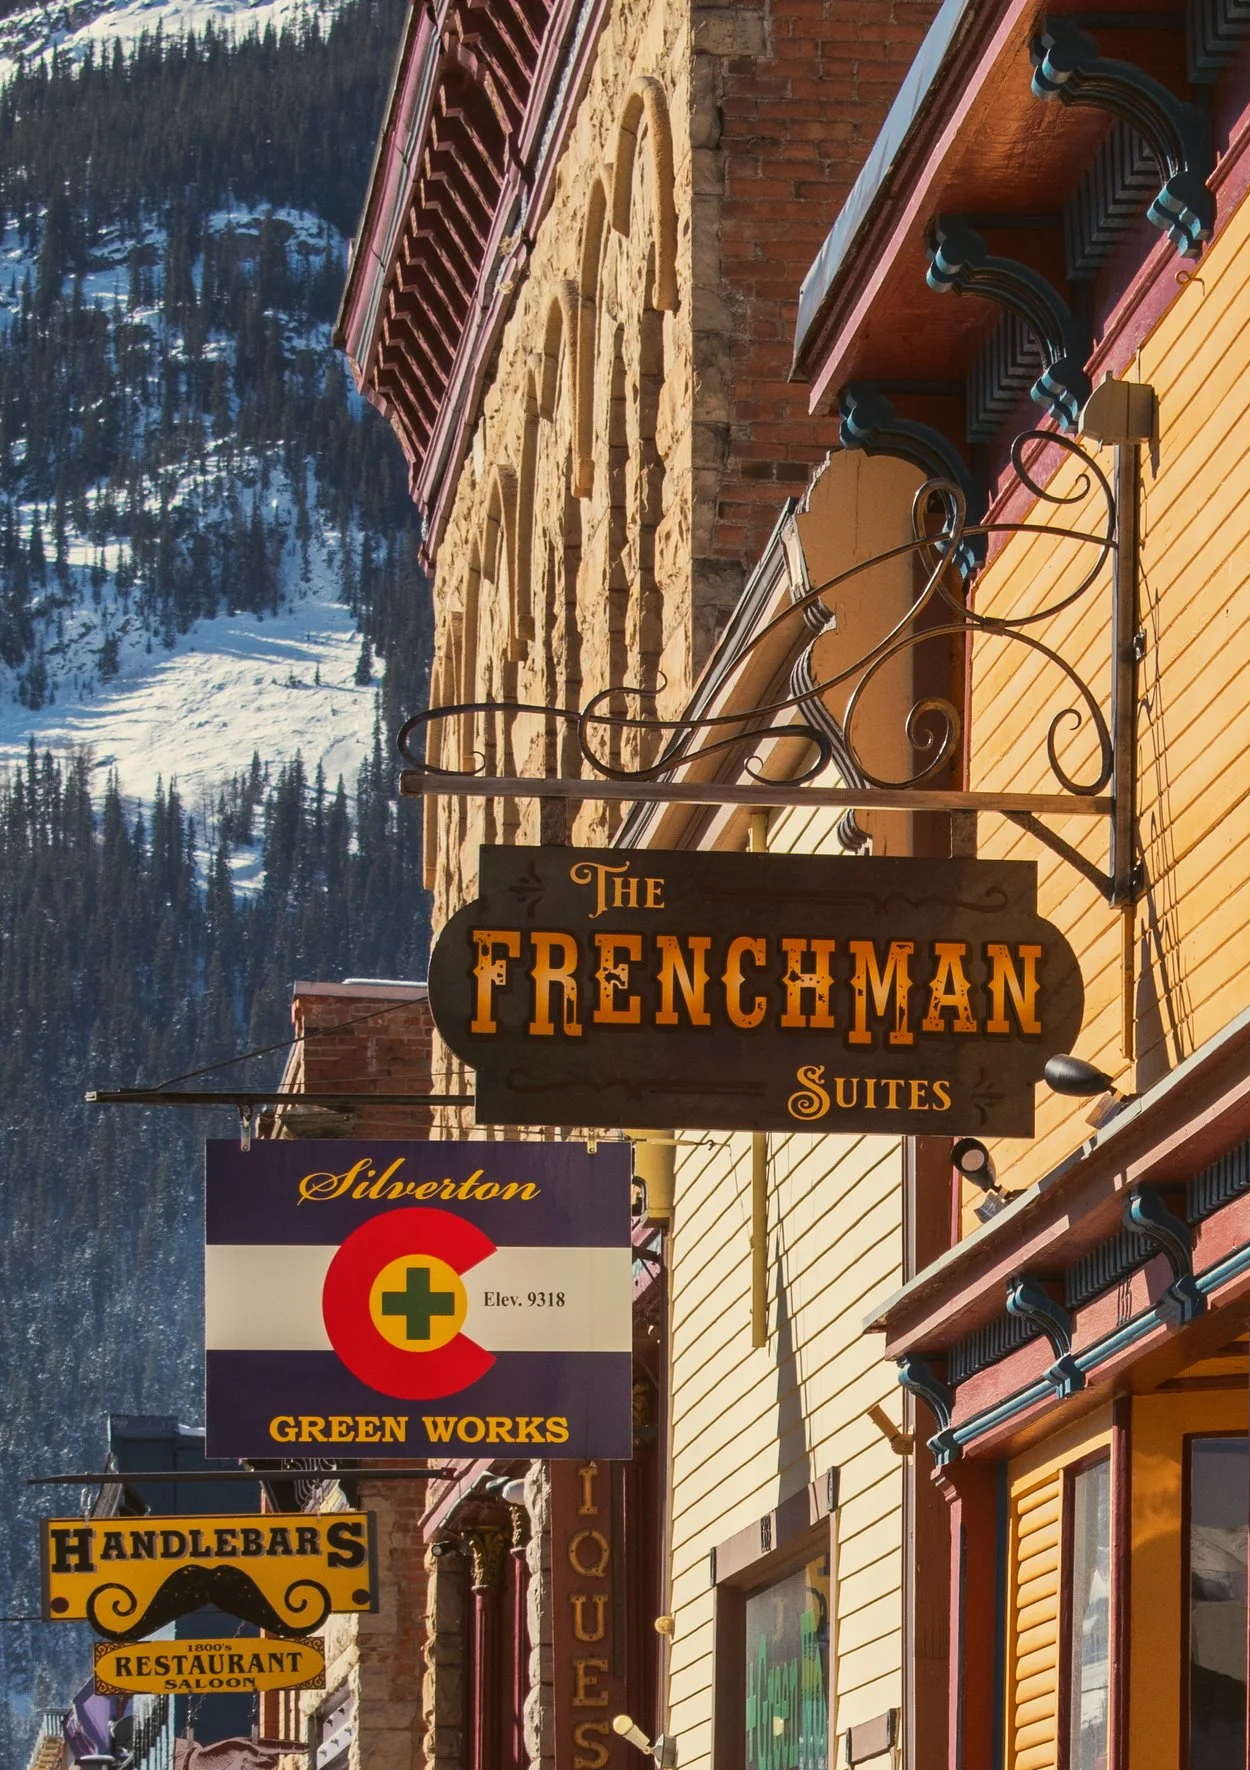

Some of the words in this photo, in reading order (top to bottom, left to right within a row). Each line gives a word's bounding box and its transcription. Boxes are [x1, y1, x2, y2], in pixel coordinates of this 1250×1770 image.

[570, 860, 665, 918] THE
[470, 928, 1043, 1046] FRENCHMAN
[788, 1065, 952, 1121] SUITES
[297, 1157, 541, 1206] Silverton
[483, 1291, 523, 1308] Elev.
[527, 1291, 566, 1308] 9318
[269, 1415, 409, 1444] GREEN
[422, 1415, 570, 1444] WORKS
[50, 1521, 368, 1574] HANDLEBARS
[114, 1652, 303, 1677] RESTAURANT
[187, 1643, 232, 1653] 1800's
[164, 1676, 256, 1690] SALOON
